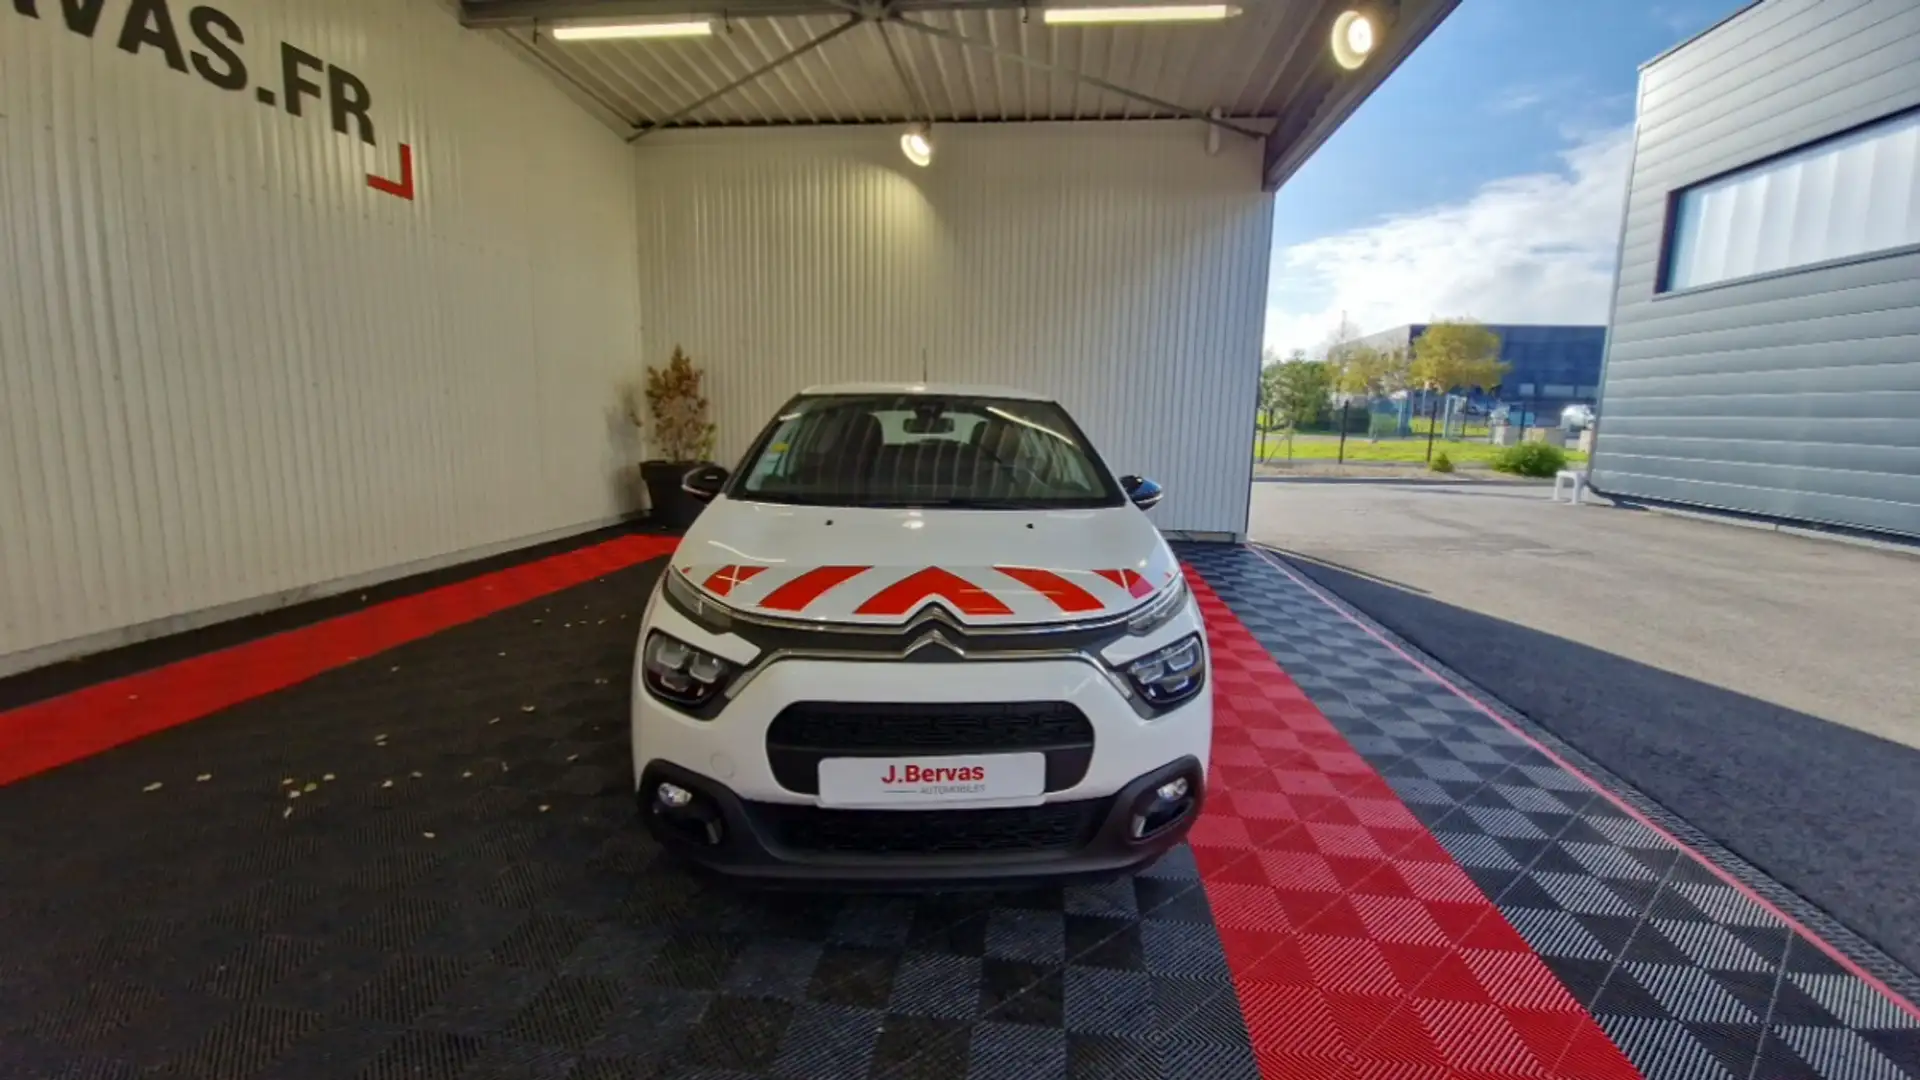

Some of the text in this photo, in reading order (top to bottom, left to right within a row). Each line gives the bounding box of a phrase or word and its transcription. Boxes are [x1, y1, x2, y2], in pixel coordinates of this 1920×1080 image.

[12, 0, 376, 146] VAS.FR
[881, 764, 985, 784] J.Bervas
[920, 784, 986, 795] AUTOMOBILES
